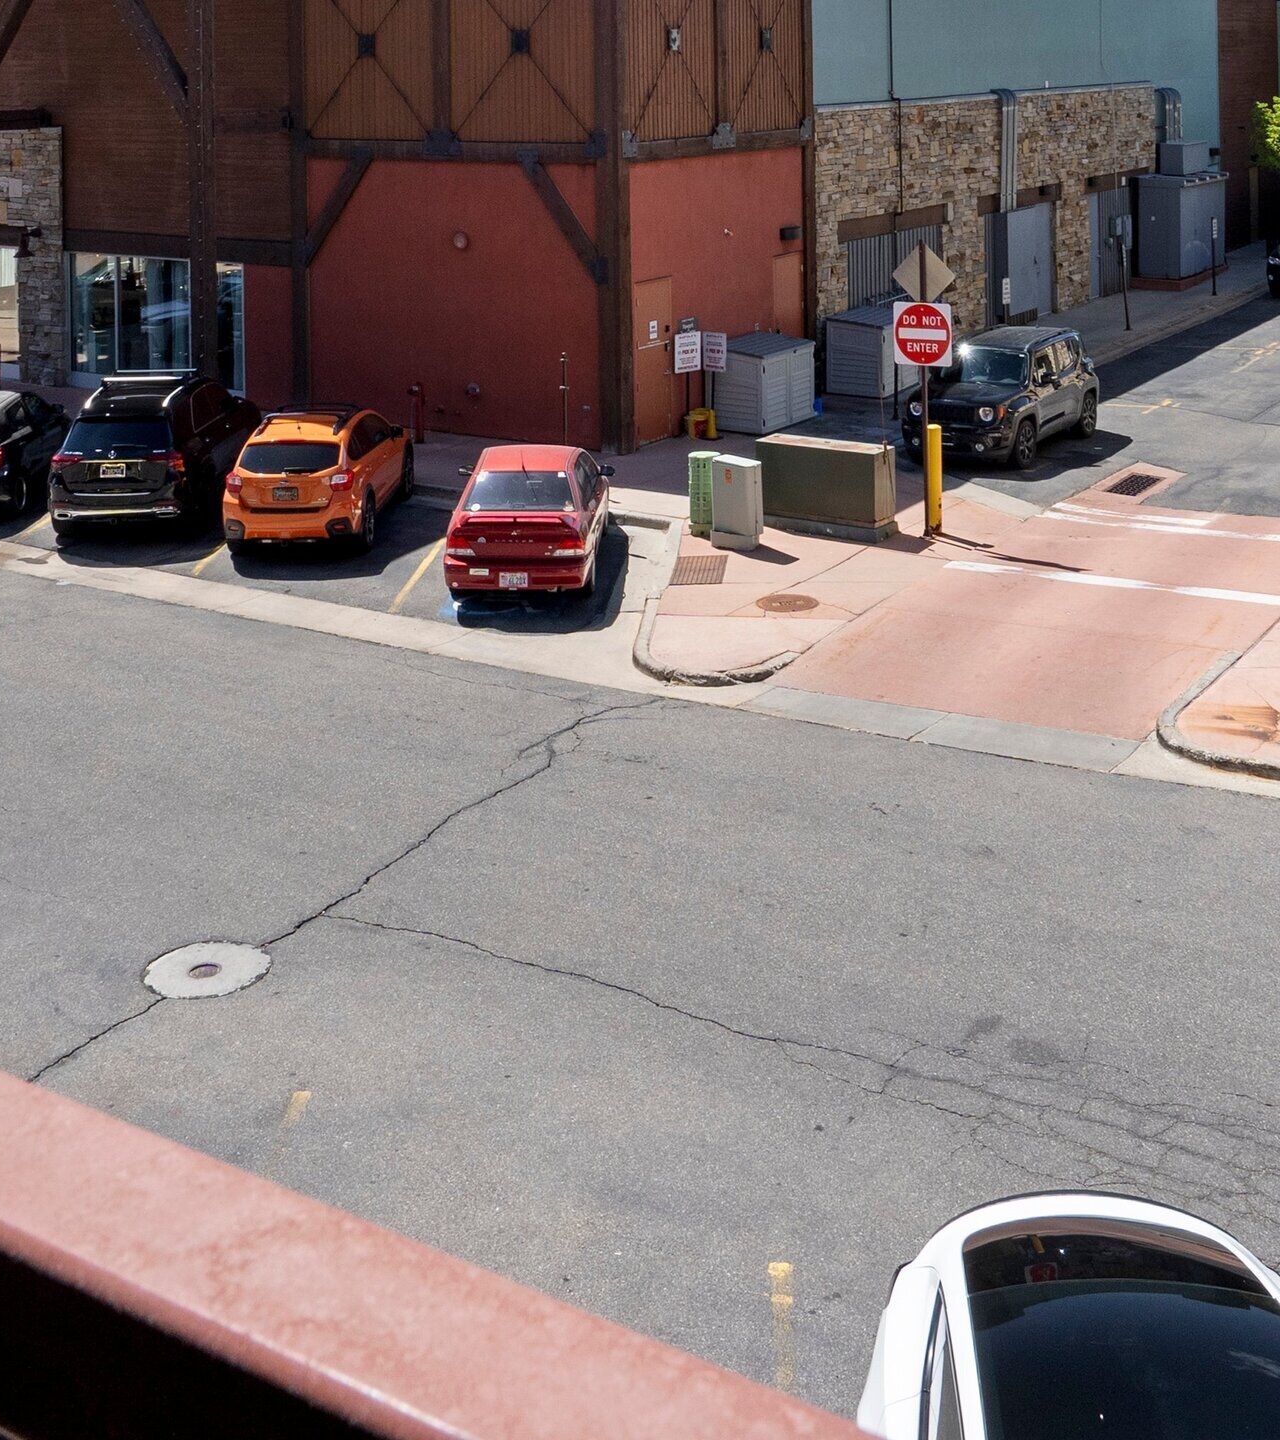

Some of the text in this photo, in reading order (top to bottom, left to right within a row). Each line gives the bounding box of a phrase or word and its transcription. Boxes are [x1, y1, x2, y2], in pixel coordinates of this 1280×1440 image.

[903, 315, 942, 326] DO NOT
[907, 342, 939, 353] ENTER
